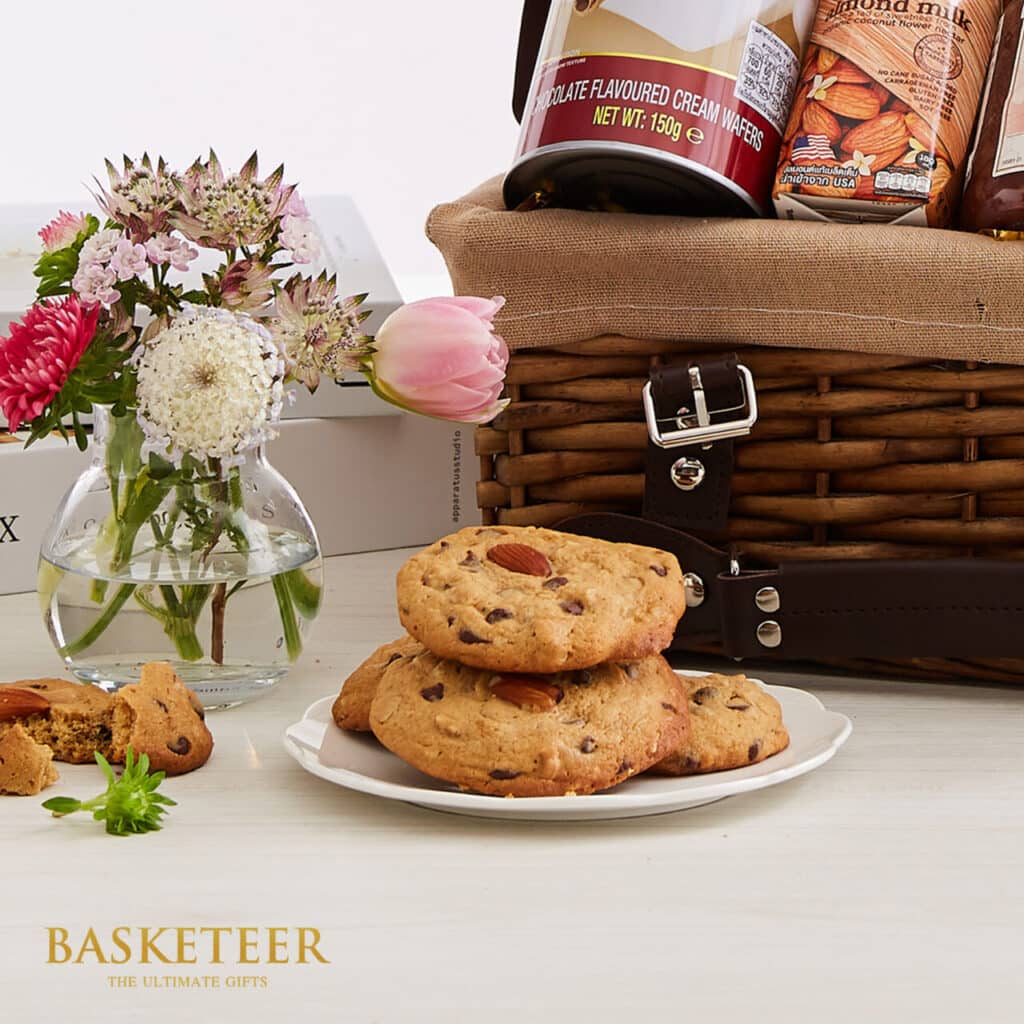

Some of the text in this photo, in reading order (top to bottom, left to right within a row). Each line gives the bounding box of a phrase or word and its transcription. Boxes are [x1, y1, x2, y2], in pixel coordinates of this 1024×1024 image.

[854, 16, 896, 28] coconut
[899, 18, 931, 30] flower
[917, 0, 973, 32] milk
[590, 79, 671, 107] FLAVOURED
[672, 89, 721, 124] CREAM
[721, 107, 764, 153] WAFERS
[592, 105, 683, 143] NET WT: 150g
[833, 177, 856, 188] USA
[452, 430, 461, 522] apparatusstudio
